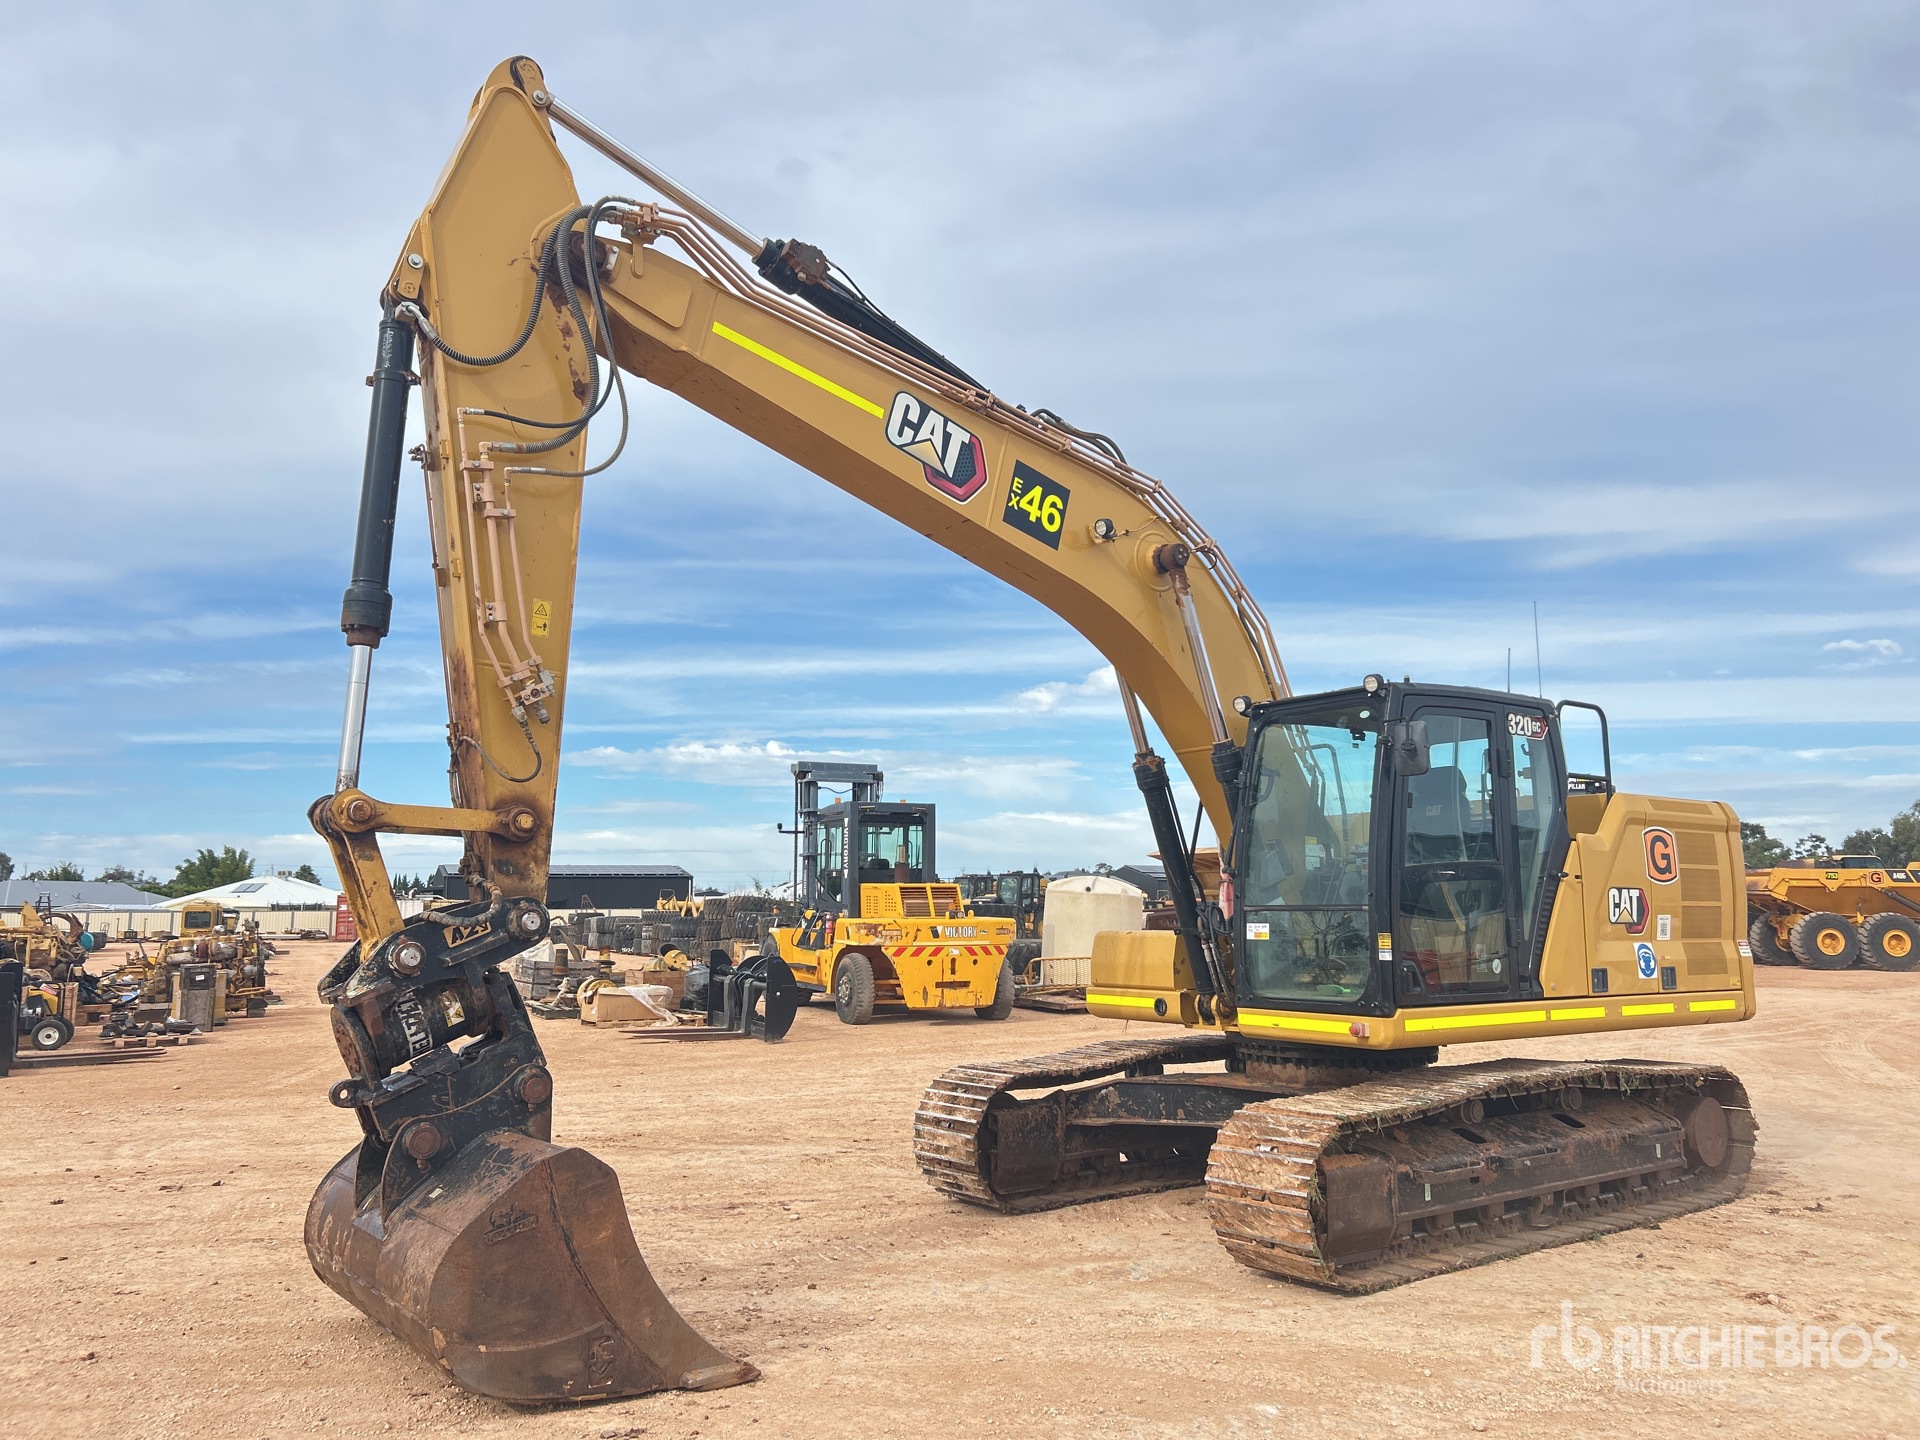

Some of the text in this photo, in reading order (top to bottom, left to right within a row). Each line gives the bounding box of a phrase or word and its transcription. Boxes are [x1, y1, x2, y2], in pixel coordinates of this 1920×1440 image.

[887, 392, 971, 479] CAT
[1019, 485, 1063, 533] 46
[1508, 713, 1541, 736] 320 GC
[1650, 834, 1673, 875] G
[1870, 872, 1882, 883] G
[1609, 888, 1640, 923] CAT
[944, 926, 977, 938] VICTORY
